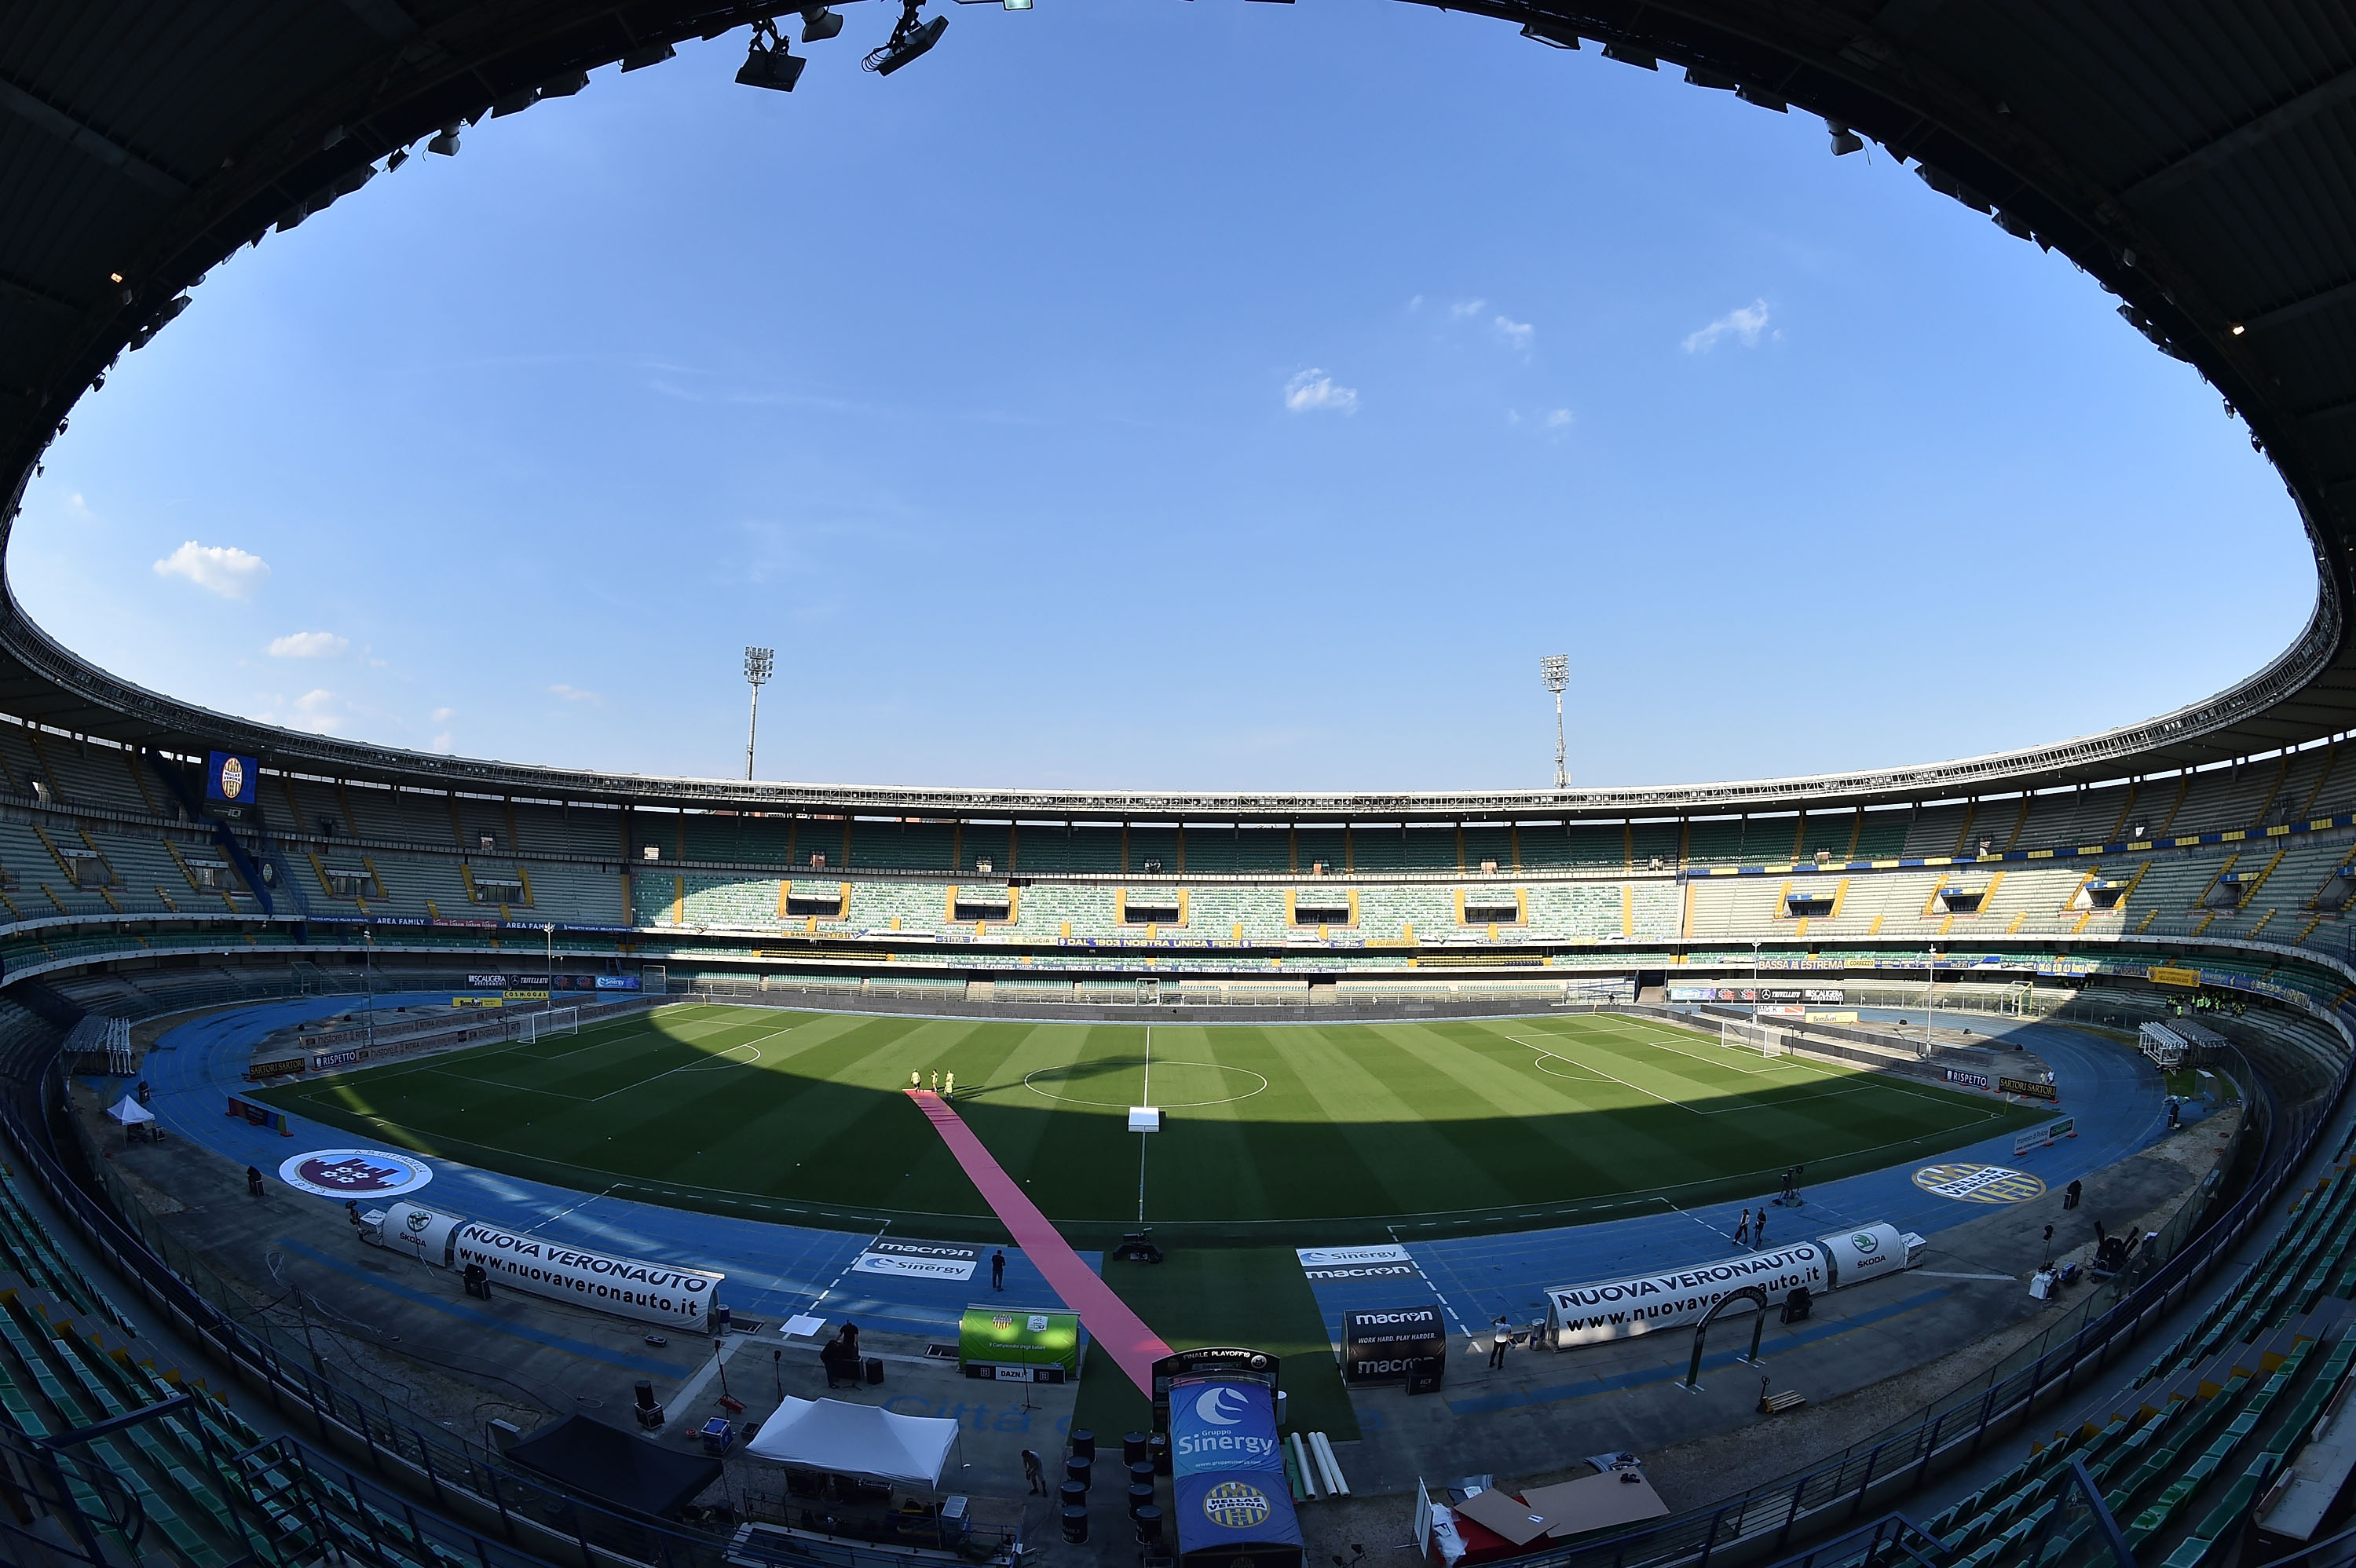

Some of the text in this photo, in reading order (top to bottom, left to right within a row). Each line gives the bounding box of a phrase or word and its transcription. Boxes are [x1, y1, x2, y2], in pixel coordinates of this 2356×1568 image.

[1758, 960, 1844, 970] BASSA ESTREMA
[322, 1051, 356, 1066] RISPETTO
[250, 1059, 305, 1075] SARTORI SARTORI
[1952, 1071, 1987, 1087] RISPETTO
[1999, 1078, 2055, 1096] SARTORI SARTORI
[289, 1178, 327, 1194] 1973
[1937, 1168, 1999, 1192] HELLAS
[1947, 1171, 2017, 1196] VERONA
[399, 1231, 426, 1247] ŠKODA
[878, 1242, 974, 1257] macron
[1331, 1250, 1396, 1260] Sinergy
[463, 1226, 708, 1293] NUOVA VERONAUTO
[896, 1260, 967, 1275] Sinergy
[1857, 1255, 1886, 1269] ŠKODA
[1305, 1265, 1411, 1279] macron
[1557, 1247, 1815, 1310] NUOVA VERONAUTO
[459, 1245, 697, 1318] www.nuovaveronauto.it
[1566, 1265, 1820, 1332] www.nuovaverauto.it
[1355, 1310, 1433, 1325] macron
[1183, 1350, 1251, 1361] FINALE PLAYOFF19
[1358, 1356, 1435, 1374] macr
[1177, 1432, 1274, 1456] Sinergy
